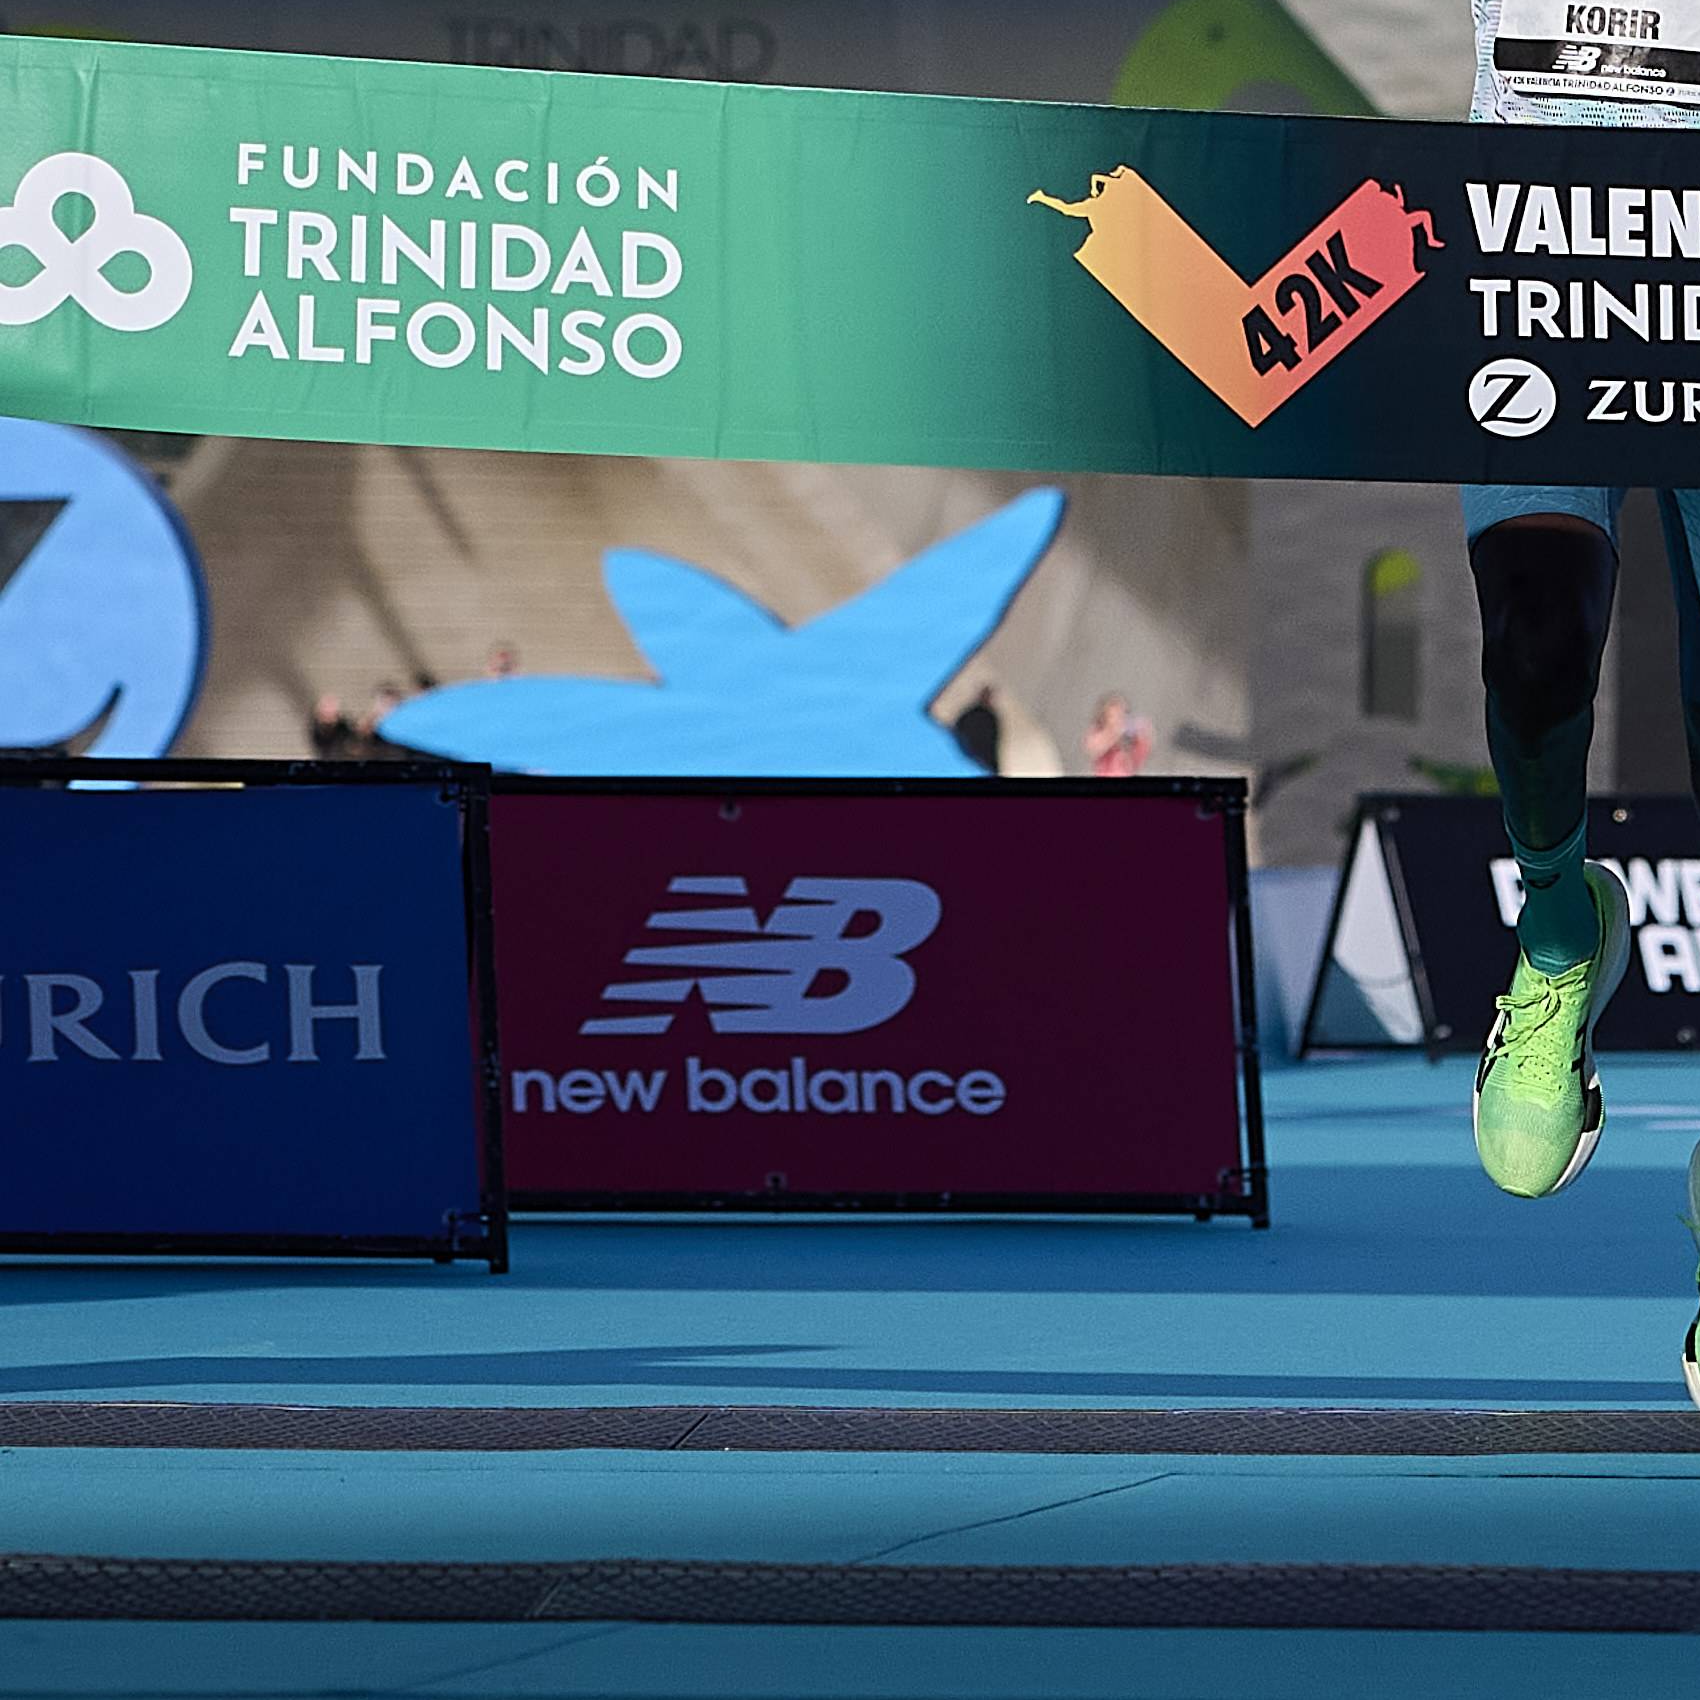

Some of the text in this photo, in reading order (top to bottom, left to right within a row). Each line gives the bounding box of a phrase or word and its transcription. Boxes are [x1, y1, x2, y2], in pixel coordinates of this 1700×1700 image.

[1565, 4, 1661, 41] KORIR
[1563, 78, 1611, 91] TRINIDAD
[1612, 83, 1664, 96] ALFONSO
[1624, 64, 1667, 78] balance
[237, 142, 679, 212] FUNDACIÓN
[229, 207, 683, 301] TRINIDAD
[228, 290, 683, 380] ALFONSO
[1240, 230, 1385, 378] 42K
[0, 961, 387, 1067] RICH
[510, 1055, 1006, 1117] new balance
